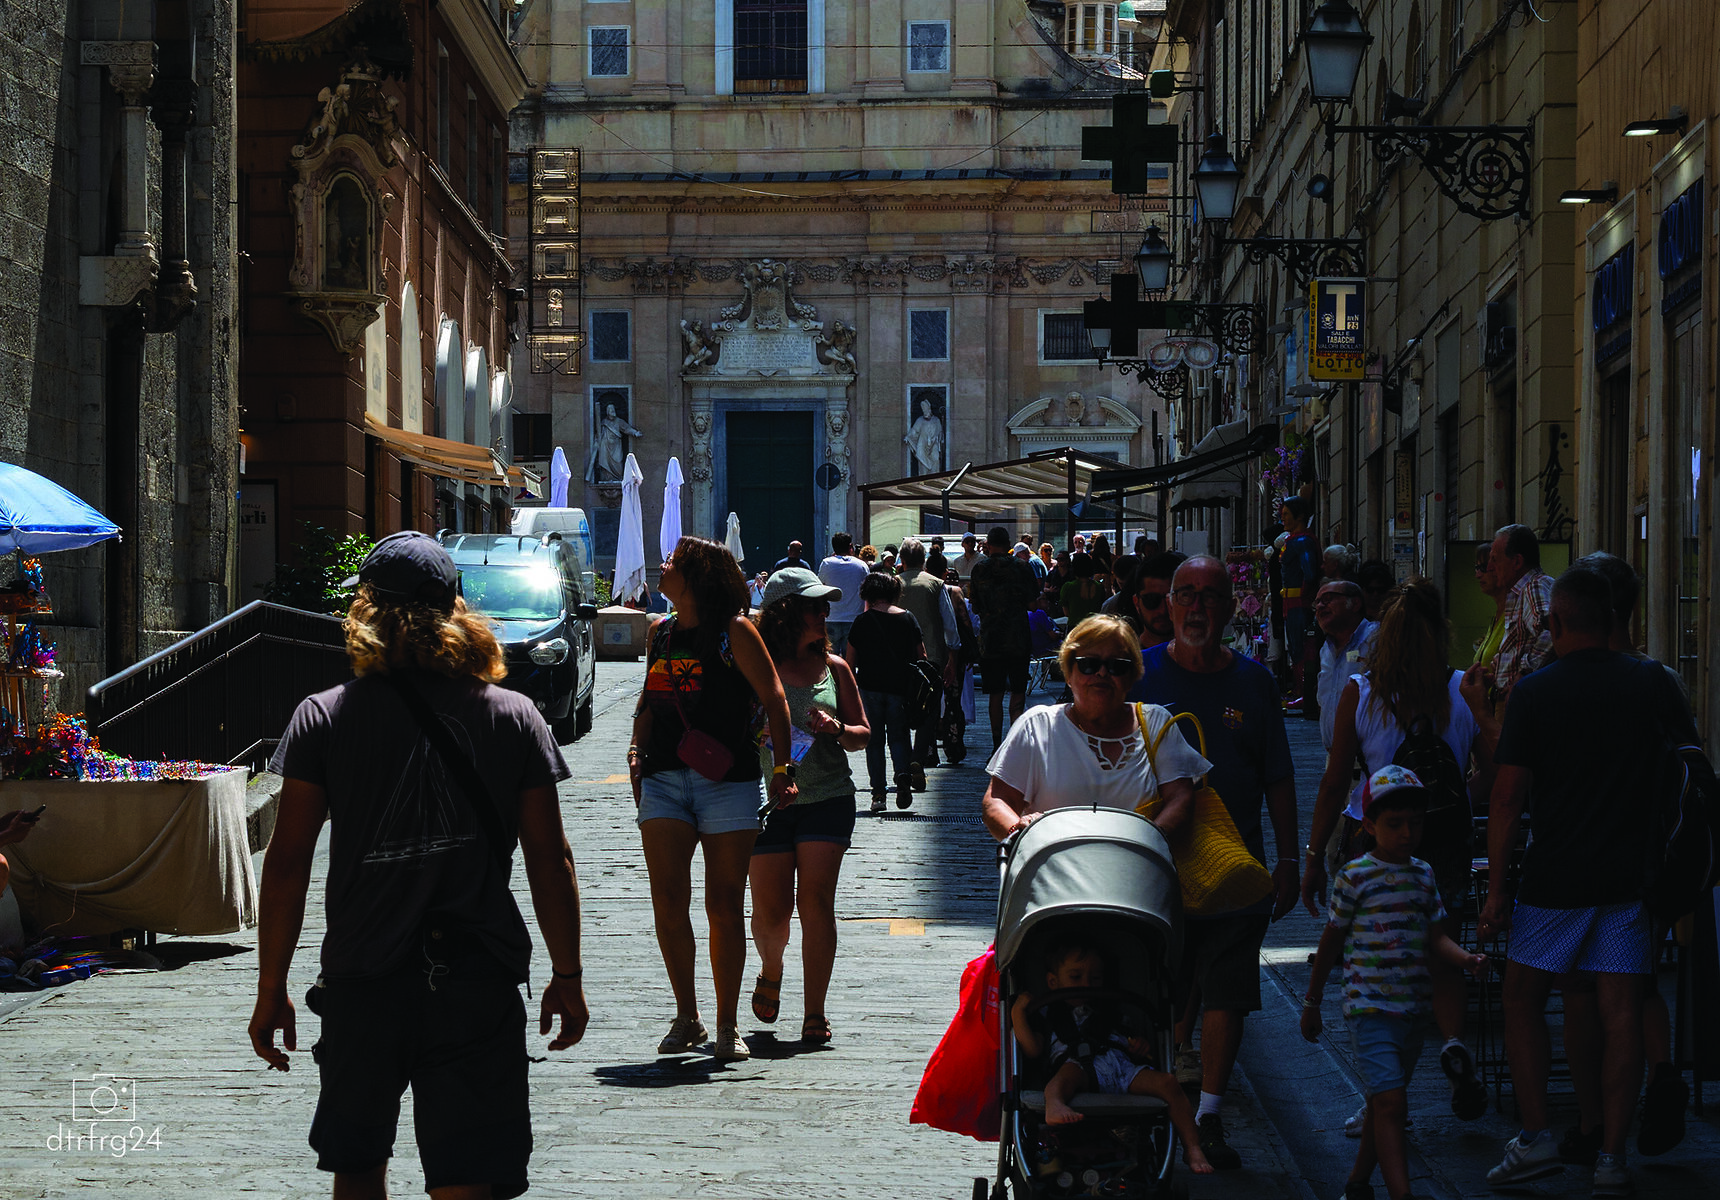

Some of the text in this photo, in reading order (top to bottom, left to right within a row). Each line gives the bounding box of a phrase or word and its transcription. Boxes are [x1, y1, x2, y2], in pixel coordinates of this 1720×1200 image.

[1326, 285, 1357, 331] T
[1327, 336, 1356, 344] TABACCHI
[1317, 358, 1364, 368] LOTTO
